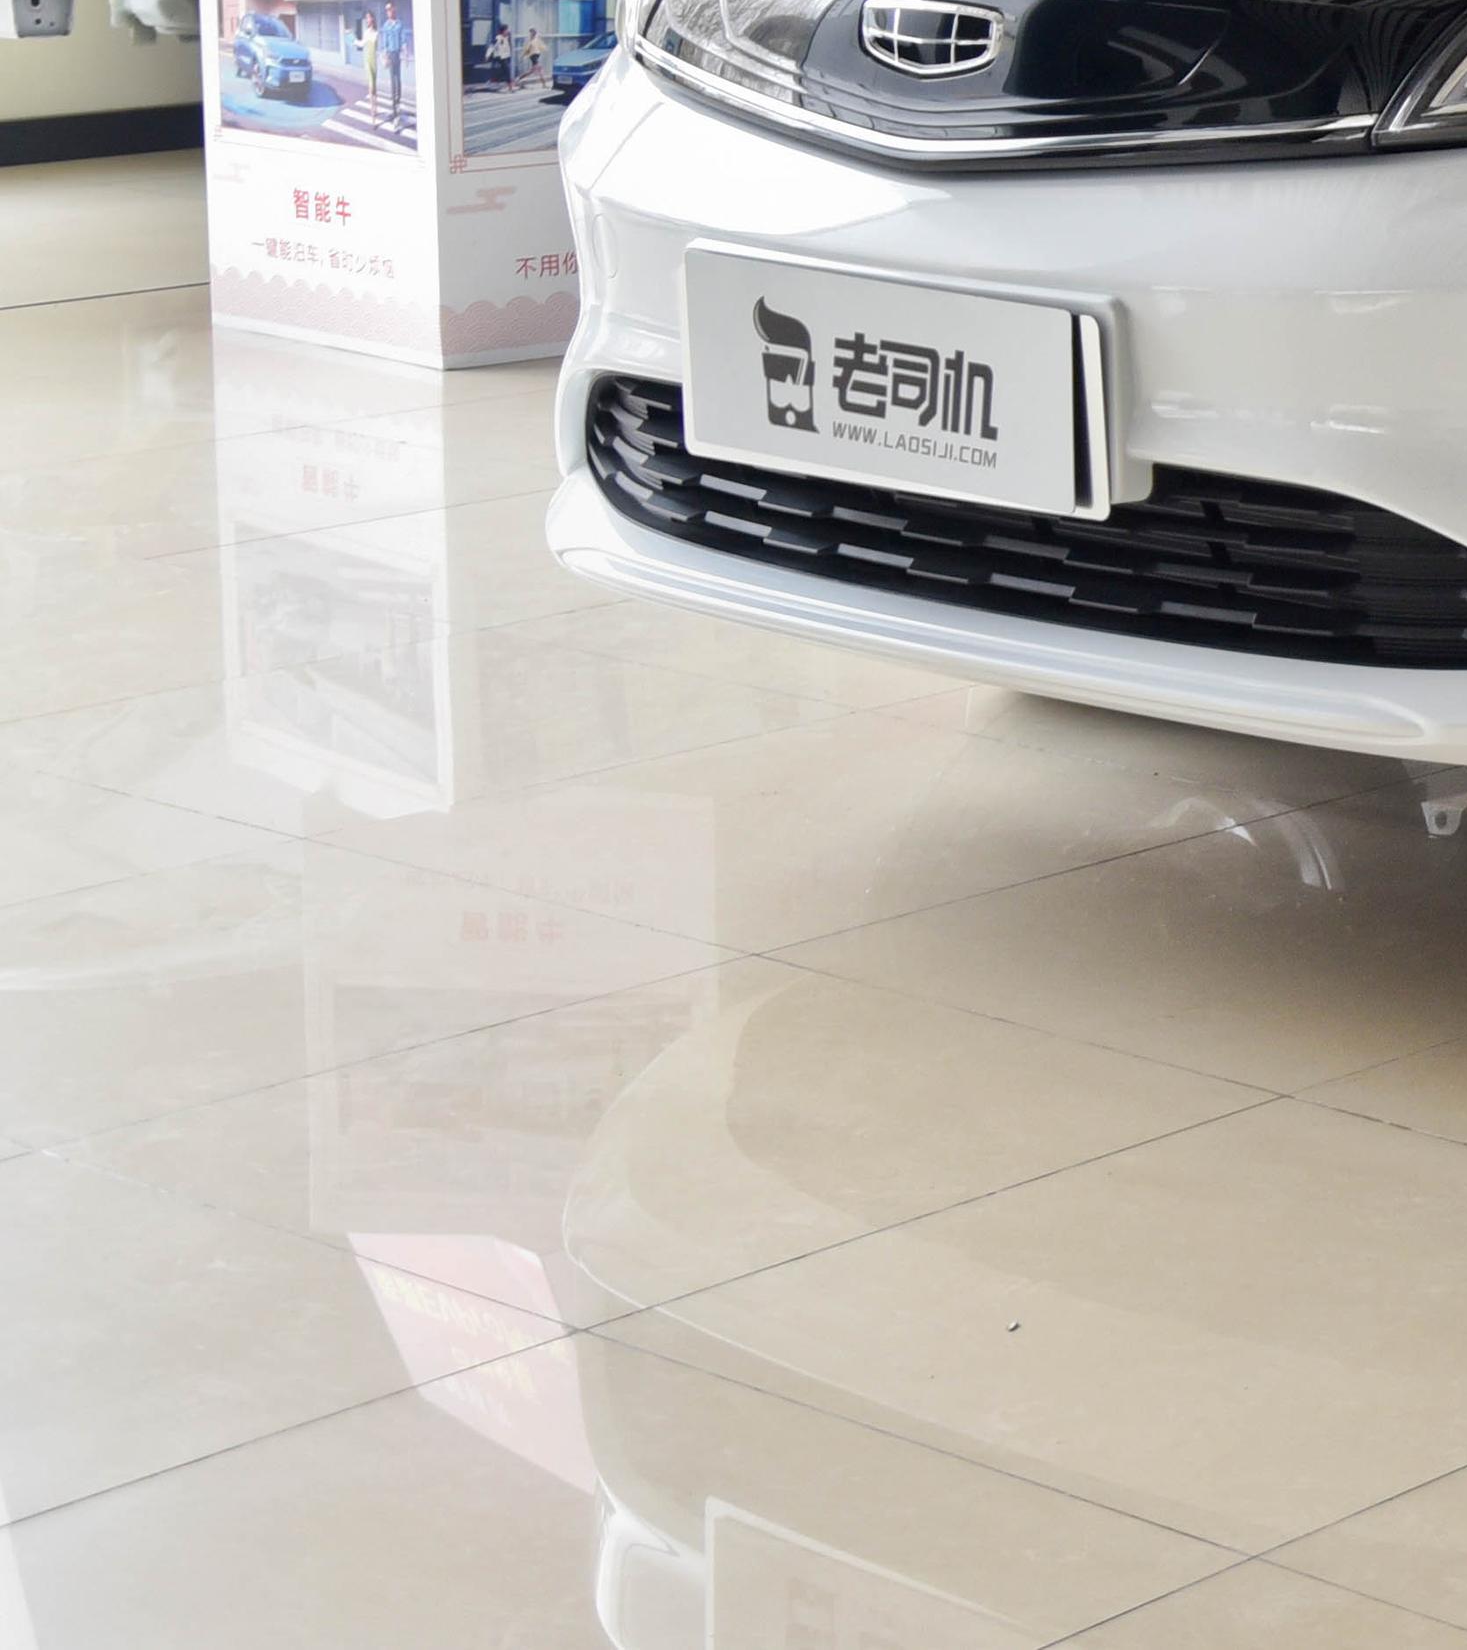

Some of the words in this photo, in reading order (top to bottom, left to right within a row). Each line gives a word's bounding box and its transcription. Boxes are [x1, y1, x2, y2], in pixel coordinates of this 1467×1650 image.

[293, 187, 352, 227] 智能牛
[831, 331, 999, 442] 老司机
[832, 420, 998, 470] WWW.LAOSIJI.COM
